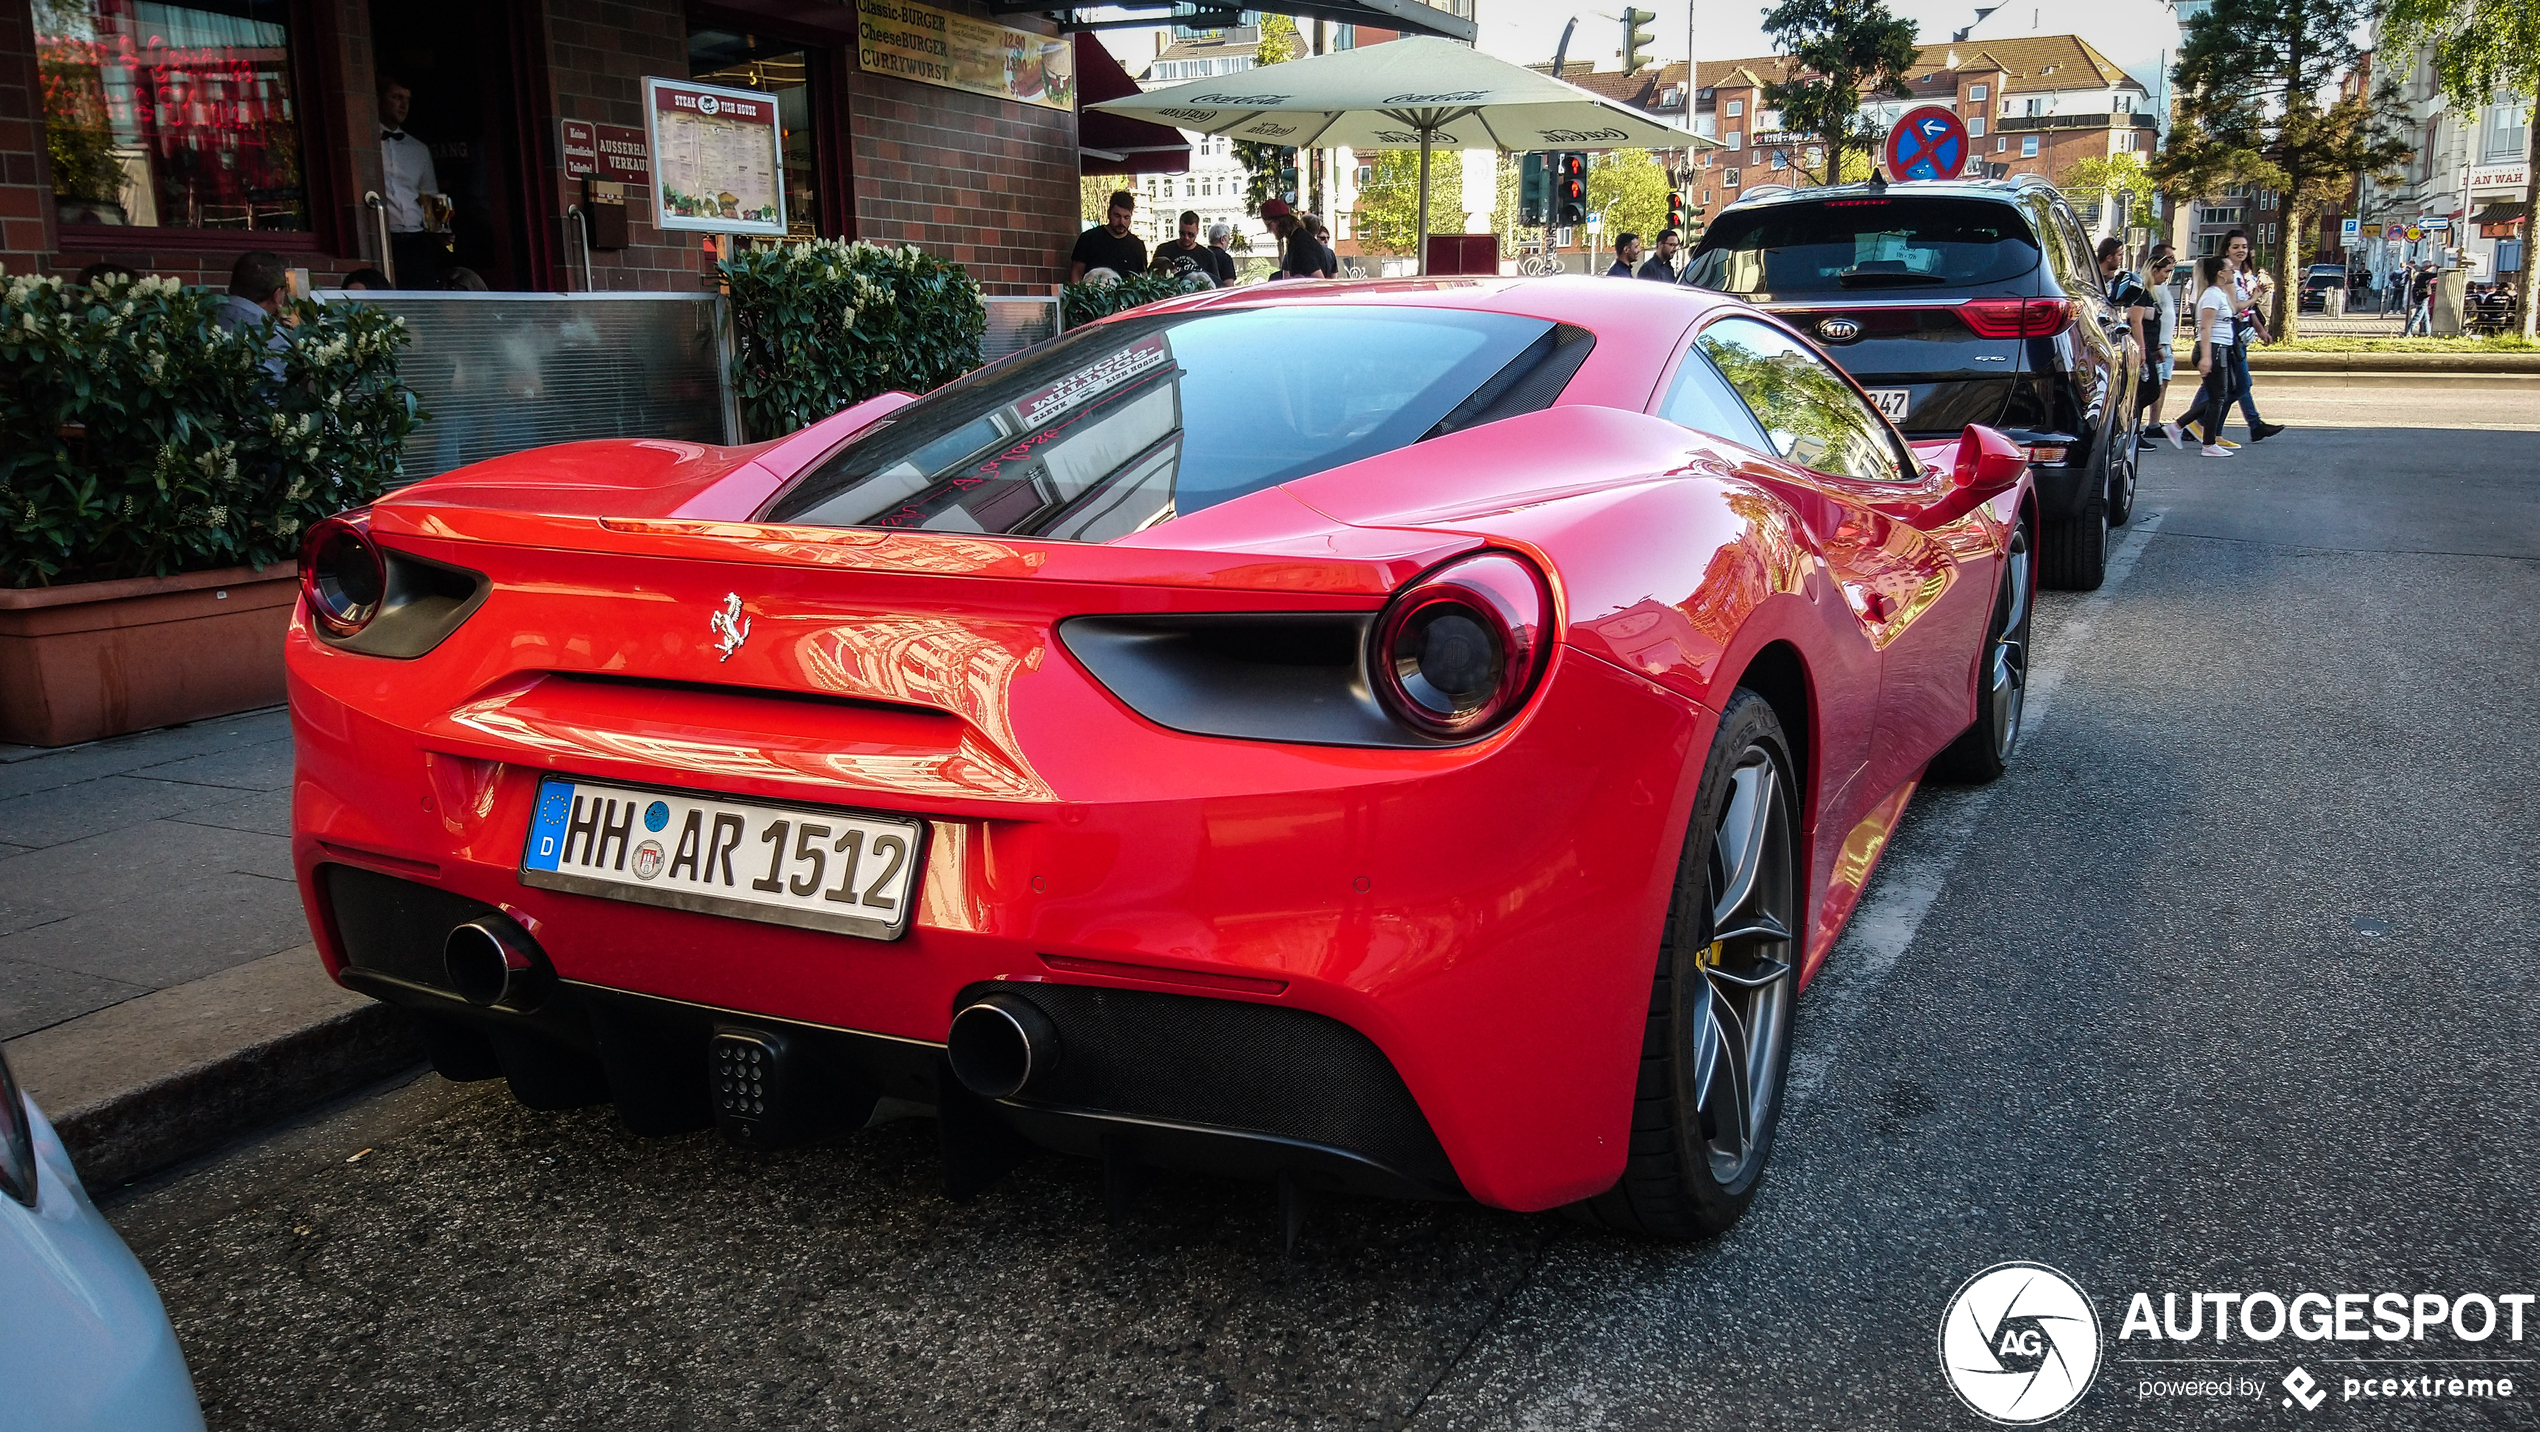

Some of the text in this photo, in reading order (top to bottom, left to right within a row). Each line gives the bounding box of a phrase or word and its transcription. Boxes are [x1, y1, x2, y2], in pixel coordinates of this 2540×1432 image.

[859, 0, 946, 32] Classic-BURGER
[860, 22, 948, 57] CheeseBURGER
[1004, 32, 1025, 51] 12,90
[861, 48, 949, 81] CURRYWURST
[674, 94, 757, 116] STEAK FISH HOUSE
[2495, 173, 2523, 184] WAH
[2347, 222, 2355, 231] P
[1826, 324, 1852, 336] KIA
[540, 836, 554, 857] D
[562, 795, 636, 871] HH
[669, 809, 745, 886] AR
[752, 820, 907, 909] 1512
